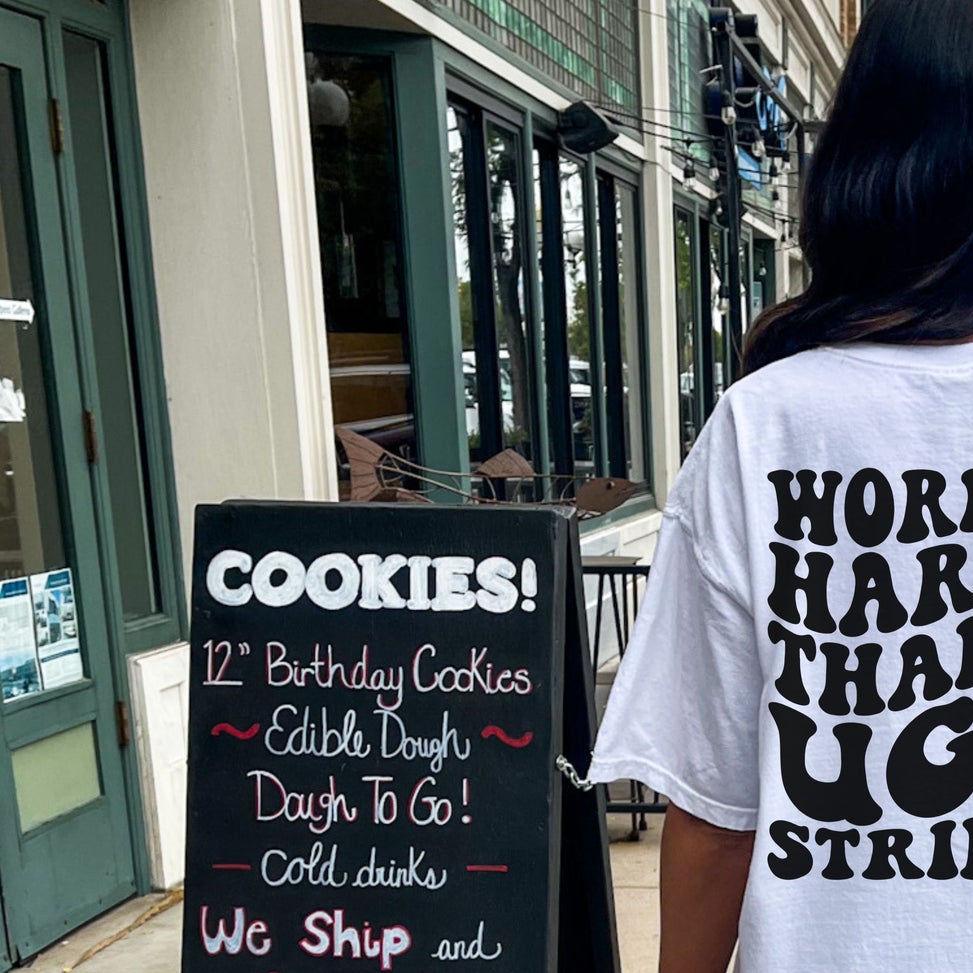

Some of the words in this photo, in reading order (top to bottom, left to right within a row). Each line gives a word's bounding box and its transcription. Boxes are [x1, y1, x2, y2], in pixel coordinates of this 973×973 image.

[206, 550, 538, 613] COOKIES!
[265, 641, 404, 710] Birthday
[265, 704, 371, 758] Edible
[374, 709, 471, 773] Dough
[247, 770, 358, 833] Dough
[362, 776, 397, 825] To
[261, 842, 347, 887] Cold
[201, 905, 272, 956] We
[298, 909, 412, 970] Ship
[431, 921, 502, 960] and
